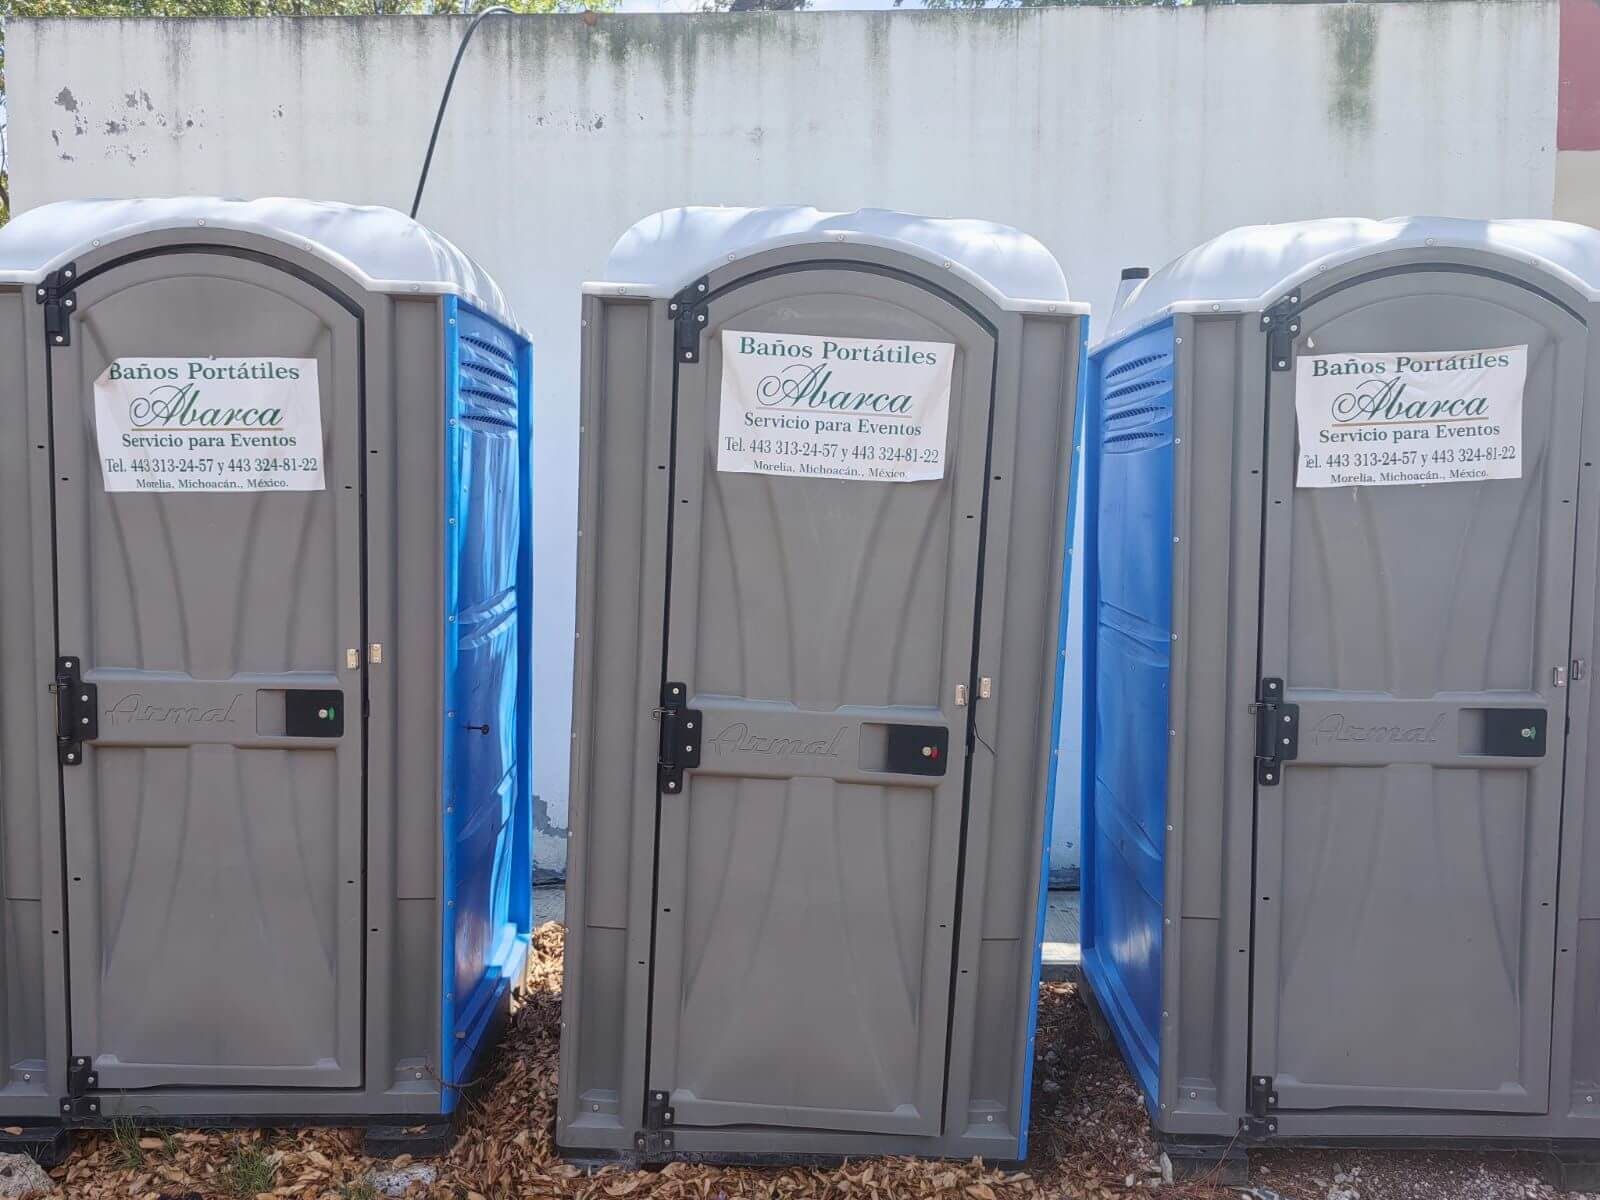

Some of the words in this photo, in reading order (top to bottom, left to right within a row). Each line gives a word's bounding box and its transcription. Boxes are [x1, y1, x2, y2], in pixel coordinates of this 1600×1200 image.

[739, 337, 813, 358] Baños
[822, 342, 937, 365] Portátiles
[110, 363, 178, 380] Baños
[188, 362, 300, 379] Portátiles
[1312, 359, 1385, 376] Baños
[1395, 353, 1509, 373] Portátiles
[756, 363, 914, 413] Abarca
[1331, 376, 1489, 422] Abarca
[129, 382, 285, 427] Abarca
[744, 412, 809, 429] Servicio
[815, 420, 851, 435] para
[858, 419, 922, 436] Eventos
[1319, 429, 1387, 443] Servicio
[1393, 428, 1429, 445] para
[1436, 425, 1500, 439] Eventos
[122, 434, 183, 447] Servicio
[189, 437, 224, 450] para
[231, 434, 297, 447] Eventos
[725, 437, 745, 451] Tel.
[749, 440, 771, 453] 443
[776, 441, 838, 457] 313-24-57
[841, 448, 848, 462] y
[852, 446, 875, 459] 443
[879, 447, 939, 463] 324-81-22
[105, 459, 126, 473] Tel.
[131, 460, 150, 472] 443
[152, 459, 213, 472] 313-24-57
[218, 461, 224, 475] y
[228, 459, 251, 472] 443
[255, 458, 317, 471] 324-81-22
[1326, 455, 1350, 467] 443
[1354, 451, 1417, 466] 313-24-57
[1421, 453, 1428, 467] y
[1432, 450, 1454, 463] 443
[1458, 446, 1516, 462] 324-81-22
